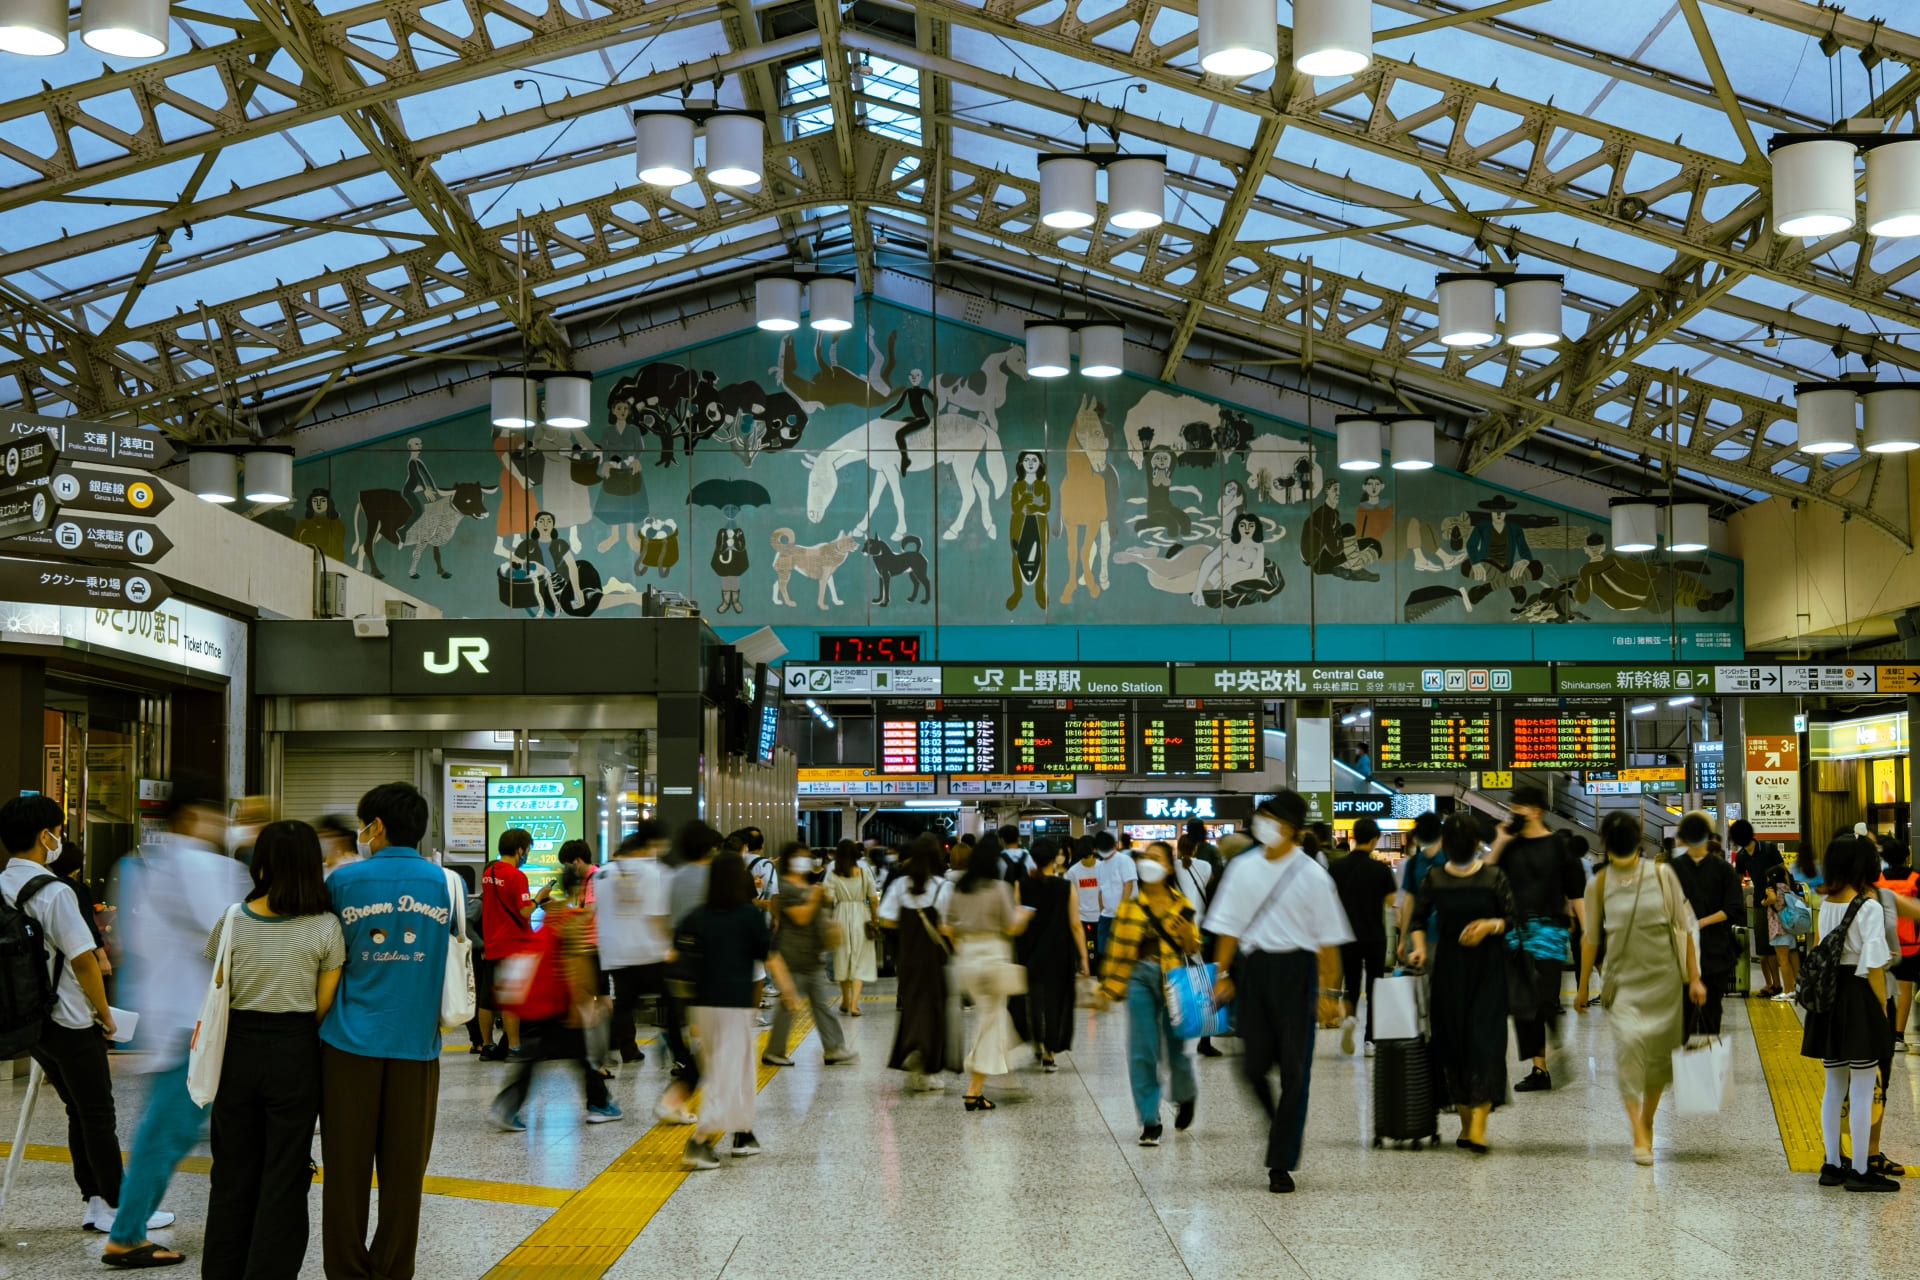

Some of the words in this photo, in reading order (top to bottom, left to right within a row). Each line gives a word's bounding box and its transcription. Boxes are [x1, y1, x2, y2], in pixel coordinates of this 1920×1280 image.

[84, 432, 108, 446] 交番
[120, 436, 154, 451] 浅草口
[118, 449, 143, 458] Asakusa
[62, 482, 71, 492] H
[89, 480, 125, 495] 銀座線
[136, 491, 145, 500] G
[87, 528, 124, 543] 公衆電話
[94, 542, 123, 550] Telephone
[40, 573, 121, 590] タクシー乗り場
[184, 635, 202, 653] Ticket
[204, 641, 222, 658] Office
[835, 638, 917, 661] 17:54
[424, 637, 490, 674] JR
[1313, 669, 1353, 680] Central
[1357, 669, 1384, 680] Gate
[1616, 671, 1670, 689] 新幹線
[974, 669, 1004, 686] JR
[1011, 669, 1080, 692] 上野駅
[1214, 669, 1306, 692] 中央改札
[1426, 676, 1438, 685] JK
[1450, 676, 1461, 685] JY
[1472, 676, 1484, 685] JU
[1495, 676, 1506, 685] JJ
[1561, 681, 1611, 690] Shinkansen
[1088, 682, 1118, 692] Ueno
[1122, 682, 1163, 692] Station
[1781, 740, 1795, 752] 3F
[1755, 776, 1789, 785] ecute
[498, 784, 562, 794] お急ぎのお荷物、
[496, 801, 575, 810] 今すぐお運びします。
[1145, 798, 1215, 818] 駅弁屋
[1333, 802, 1354, 812] GIFT
[1356, 801, 1384, 812] SHOP
[541, 854, 557, 863] 120
[342, 902, 394, 925] Brown
[397, 895, 449, 924] Donuts
[373, 950, 410, 961] Catalina
